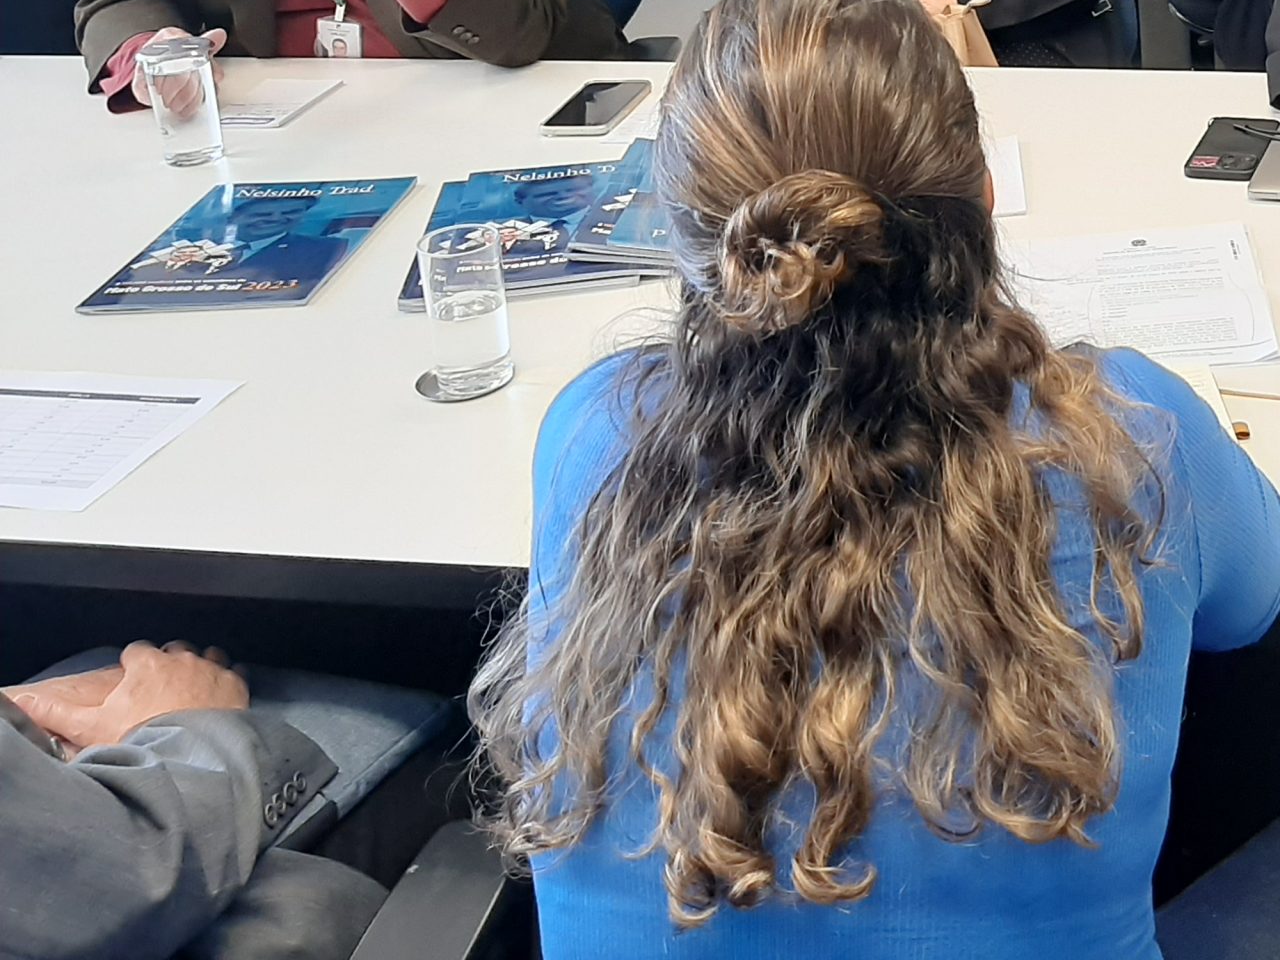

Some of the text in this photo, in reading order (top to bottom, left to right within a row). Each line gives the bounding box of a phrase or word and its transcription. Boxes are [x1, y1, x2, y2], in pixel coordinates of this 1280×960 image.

[503, 168, 592, 182] Nelsinho
[235, 184, 375, 198] Nelsinho Trad
[215, 283, 242, 291] Sul
[241, 279, 300, 290] 2023
